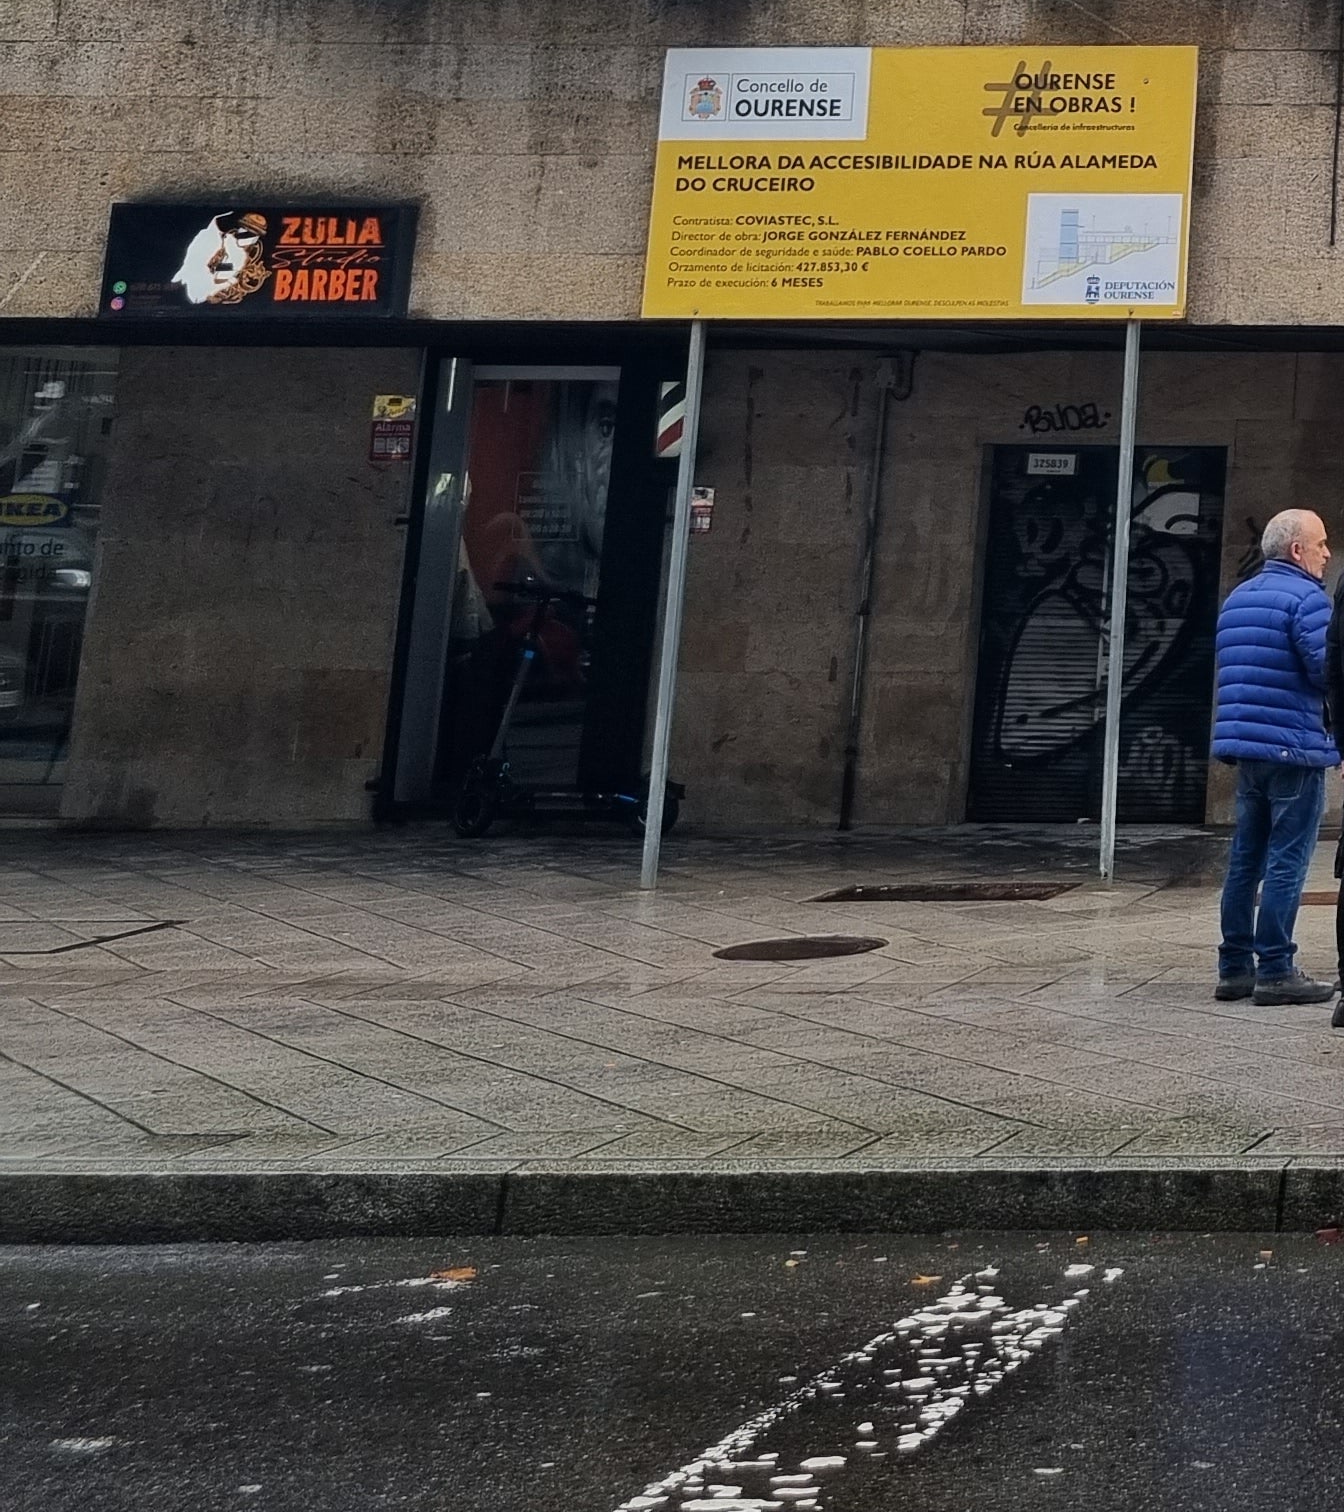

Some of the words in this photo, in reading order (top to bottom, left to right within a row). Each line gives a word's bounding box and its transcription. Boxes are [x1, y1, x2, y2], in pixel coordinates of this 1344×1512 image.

[736, 78, 805, 93] Concello
[809, 78, 828, 93] de
[1014, 73, 1116, 90] OURENSE
[735, 98, 842, 117] OURENSE
[1013, 96, 1043, 113] EN
[1049, 96, 1122, 113] OBRAS
[1060, 123, 1070, 131] de
[1072, 123, 1136, 132] infraestructuras
[677, 155, 772, 170] MELLORA
[777, 155, 805, 170] DA
[809, 154, 973, 170] ACCESIBILIDADE
[978, 154, 1008, 169] NA
[1013, 151, 1056, 169] RÚA
[1059, 154, 1158, 169] ALAMEDA
[675, 177, 706, 192] DO
[711, 177, 815, 192] CRUCEIRO
[672, 215, 733, 226] Contratista:
[735, 215, 815, 227] COVIASTEC,
[817, 215, 839, 226] S.L.
[279, 215, 382, 245] ZULIA
[671, 231, 716, 241] Director
[718, 231, 732, 241] de
[734, 231, 761, 241] obra:
[762, 230, 805, 243] JORGE
[808, 228, 882, 241] GONZÁLEZ
[885, 228, 966, 241] FERNÁNDEZ
[271, 248, 389, 269] Studio
[669, 246, 736, 257] Coordinador
[739, 246, 752, 257] de
[755, 246, 810, 259] seguridade
[812, 249, 819, 257] e
[855, 246, 899, 257] PABLO
[902, 246, 957, 257] COELLO
[960, 246, 1007, 257] PARDO
[668, 261, 728, 273] Orzamento
[730, 262, 743, 272] de
[746, 261, 794, 272] licitación:
[796, 261, 858, 274] 427.853,30
[861, 261, 870, 272] €
[273, 268, 378, 302] BARBER
[667, 277, 697, 288] Prazo
[699, 277, 712, 288] de
[715, 277, 769, 288] execución:
[770, 277, 778, 288] 6
[781, 277, 824, 288] MESES
[1104, 280, 1175, 290] DEPUTACIÓN
[1103, 291, 1155, 300] OURENSE
[40, 538, 65, 556] de
